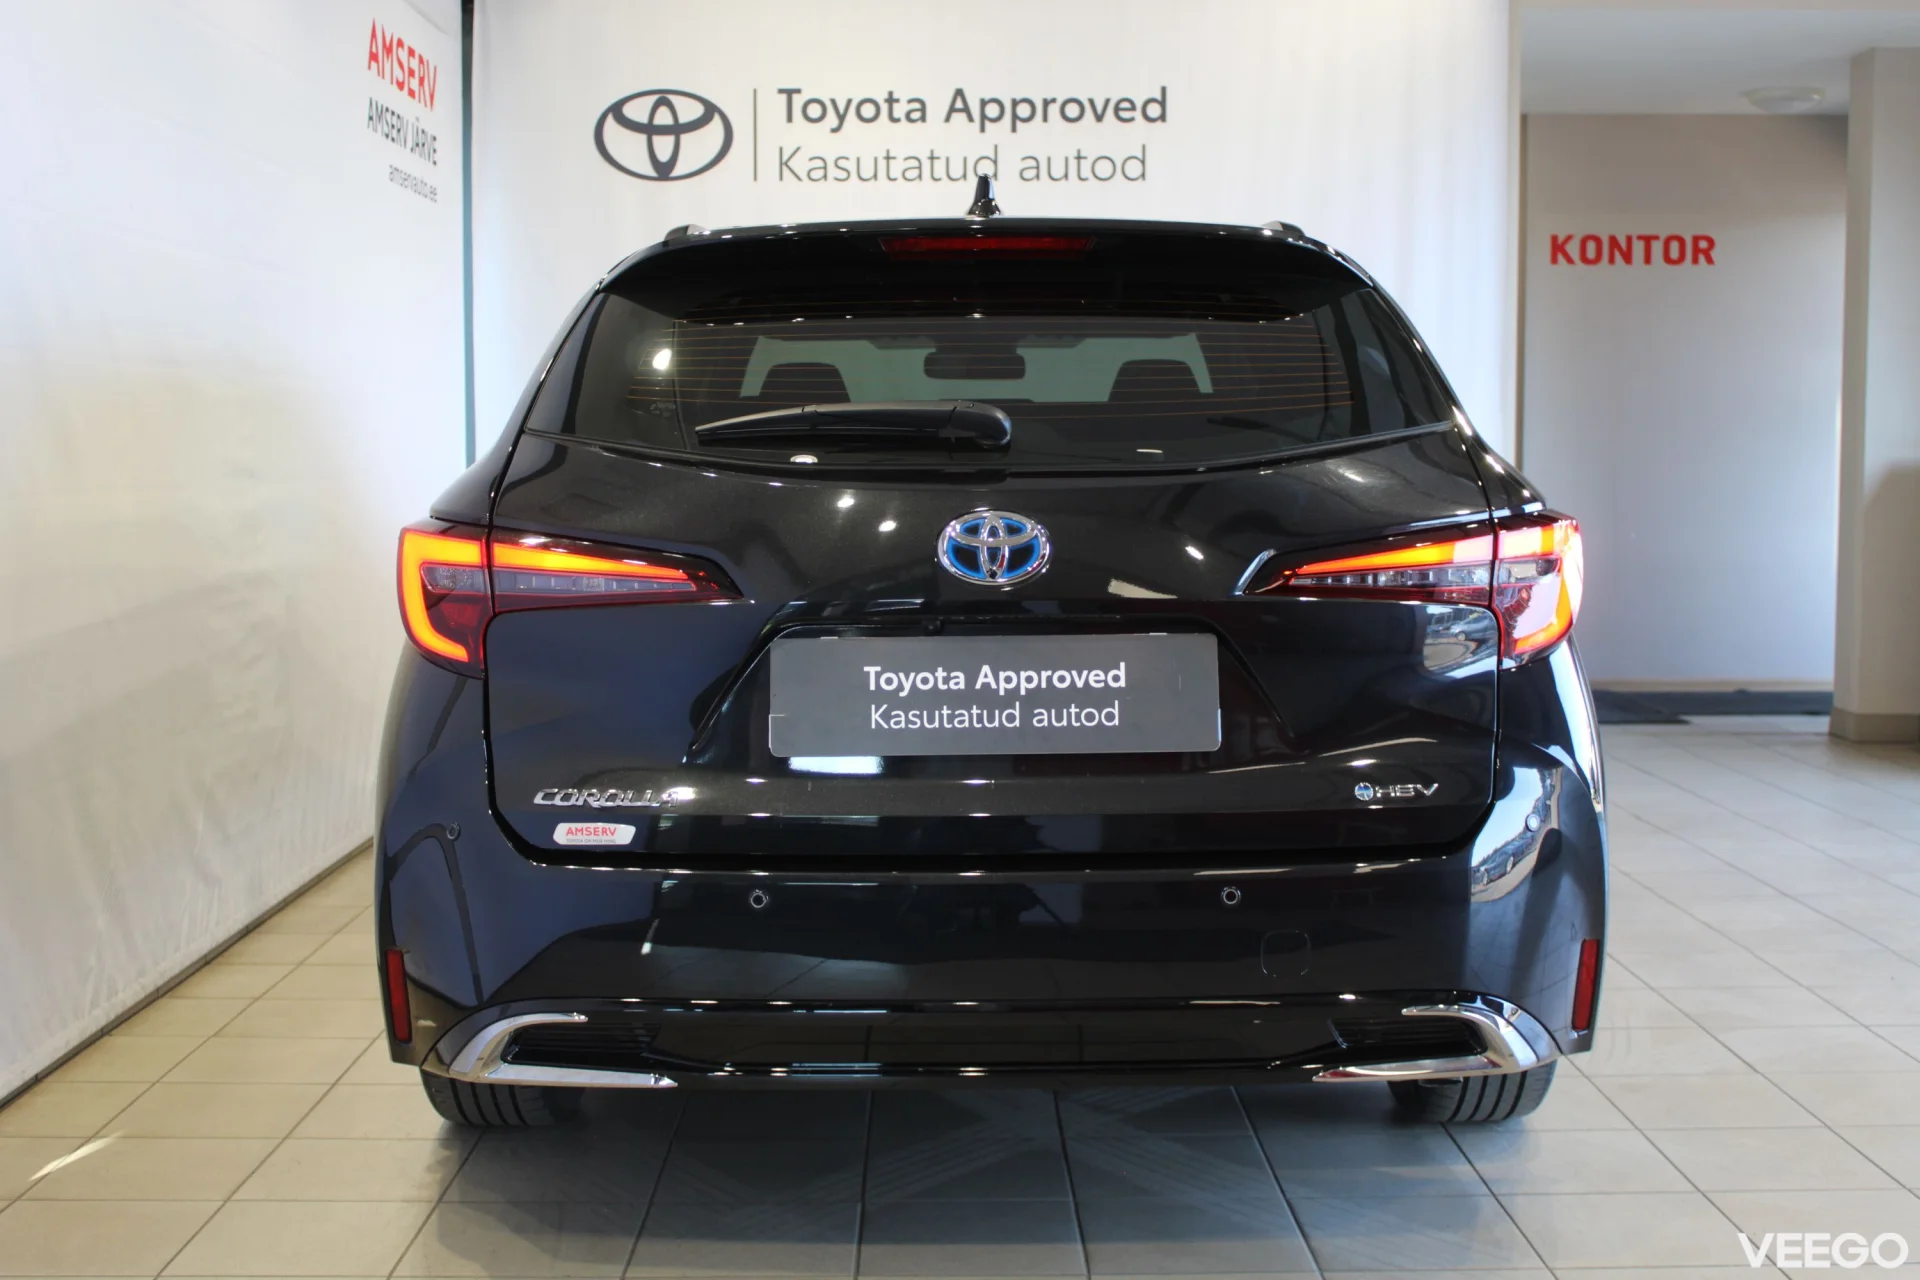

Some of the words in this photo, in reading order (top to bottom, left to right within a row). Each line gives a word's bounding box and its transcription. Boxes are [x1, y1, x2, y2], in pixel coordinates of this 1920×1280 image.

[368, 17, 437, 112] AMSERV
[777, 88, 928, 133] Toyota
[944, 86, 1168, 133] Approved
[367, 97, 409, 149] AMSERV
[410, 116, 437, 166] JÄRVE
[777, 144, 998, 182] Kasutatud
[1018, 144, 1147, 182] autod
[1550, 233, 1716, 266] KONTOR
[863, 666, 965, 697] Toyota
[975, 662, 1126, 696] Approved
[871, 701, 1020, 729] Kasutatud
[1033, 700, 1120, 727] autod
[533, 788, 678, 808] COROLLA
[1375, 783, 1439, 797] HEV
[566, 826, 617, 837] AMSERV
